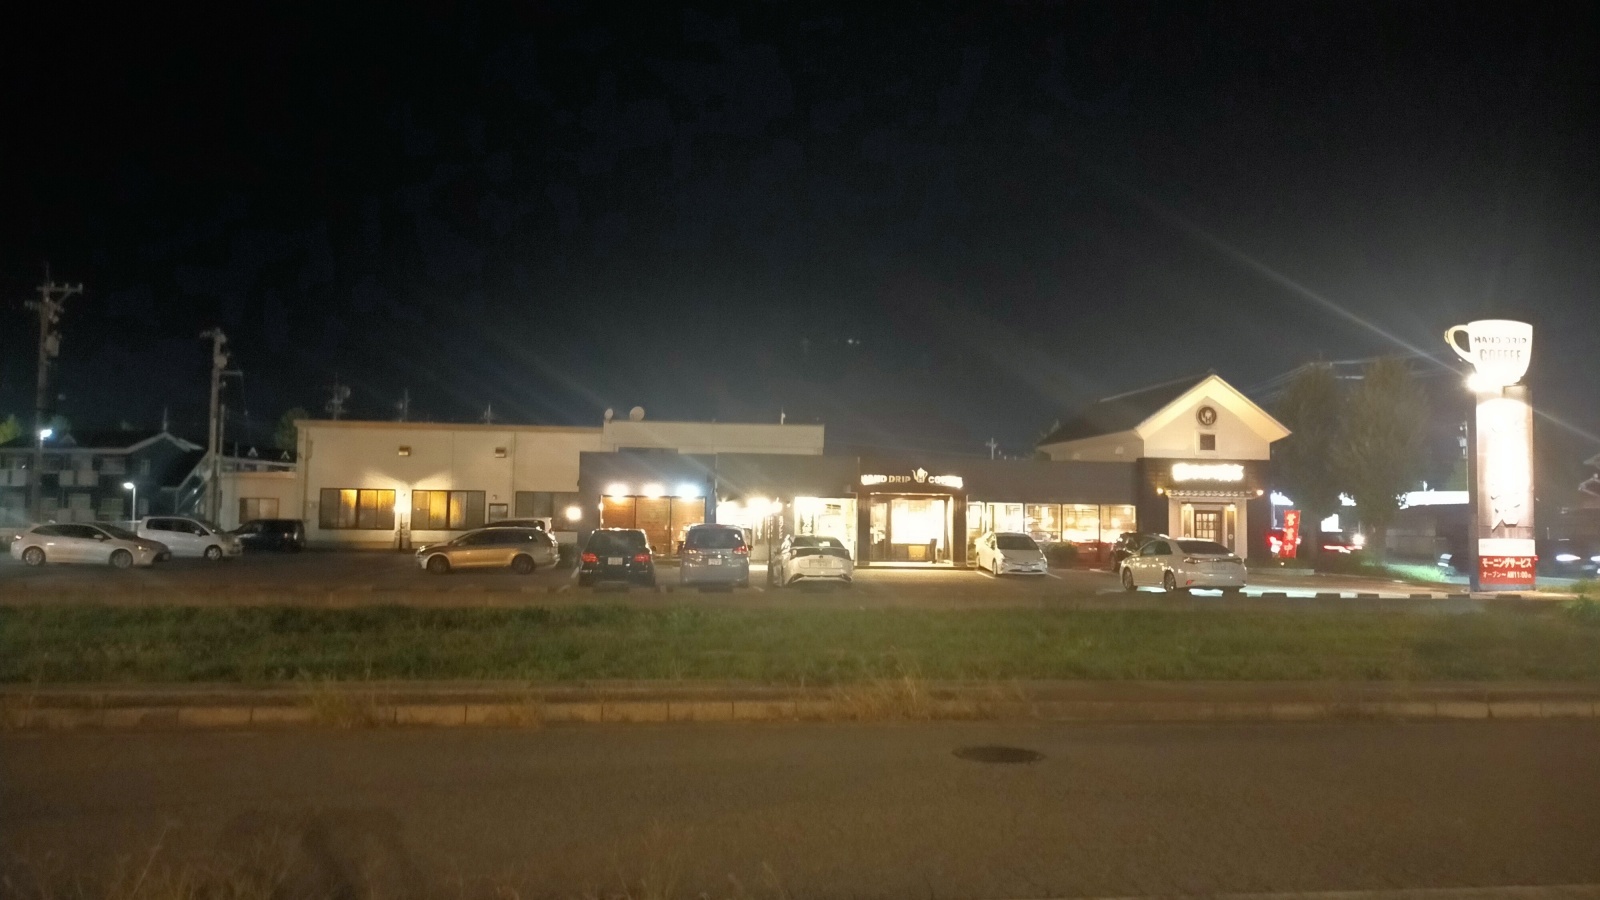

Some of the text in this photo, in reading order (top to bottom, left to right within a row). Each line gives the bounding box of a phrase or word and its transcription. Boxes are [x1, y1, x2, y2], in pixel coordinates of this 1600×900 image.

[888, 475, 911, 483] DRIP
[1482, 557, 1532, 568] モーニングサービス
